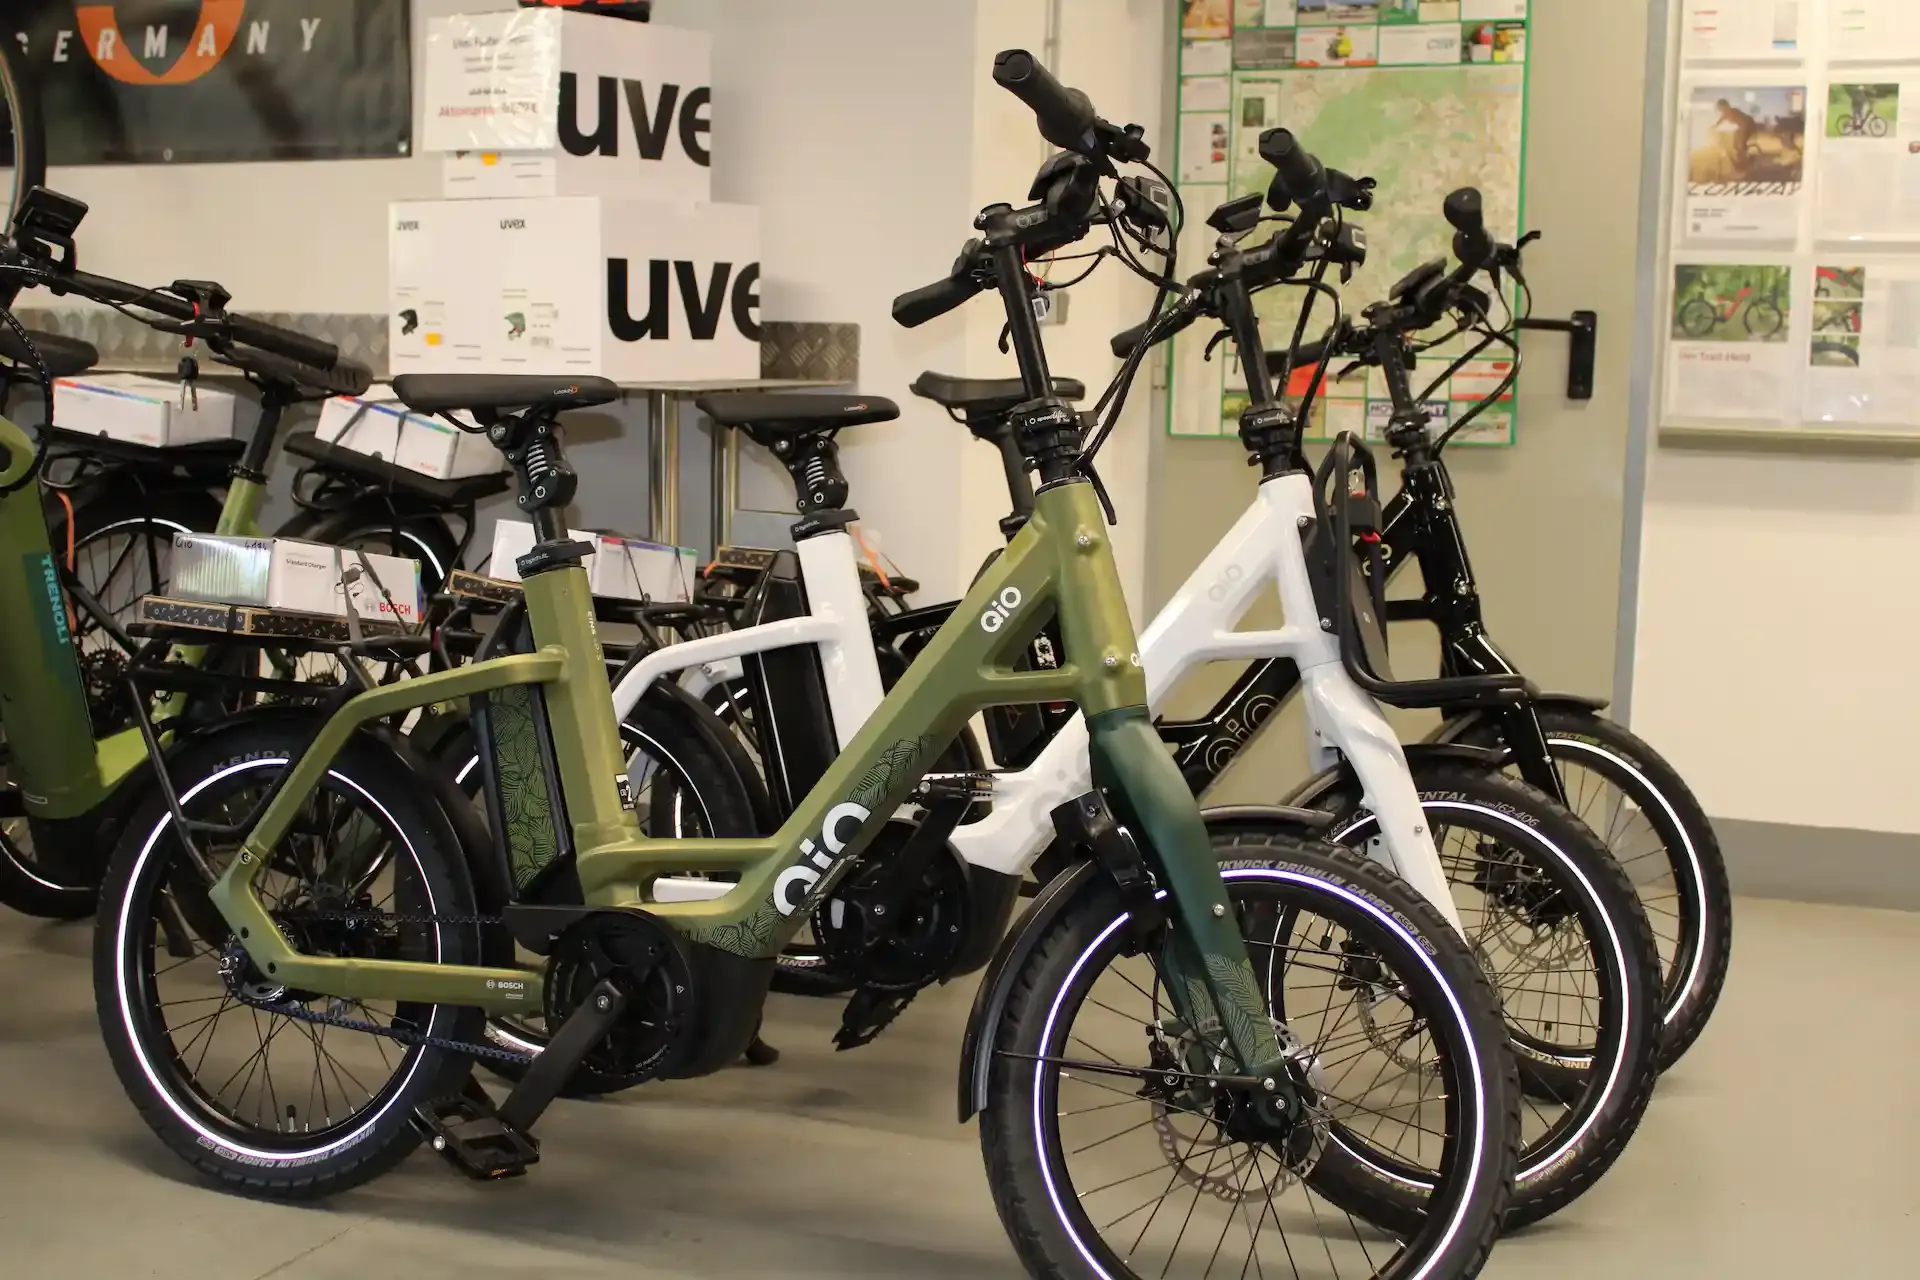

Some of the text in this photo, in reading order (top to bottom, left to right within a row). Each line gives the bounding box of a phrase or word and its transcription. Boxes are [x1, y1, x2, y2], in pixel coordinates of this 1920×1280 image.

[500, 218, 527, 230] uvex
[286, 558, 327, 571] Standard Charger
[212, 750, 291, 773] KENDA
[1275, 860, 1346, 886] DRUMLIN
[1346, 883, 1394, 912] CARGO
[498, 981, 524, 990] BOSCH
